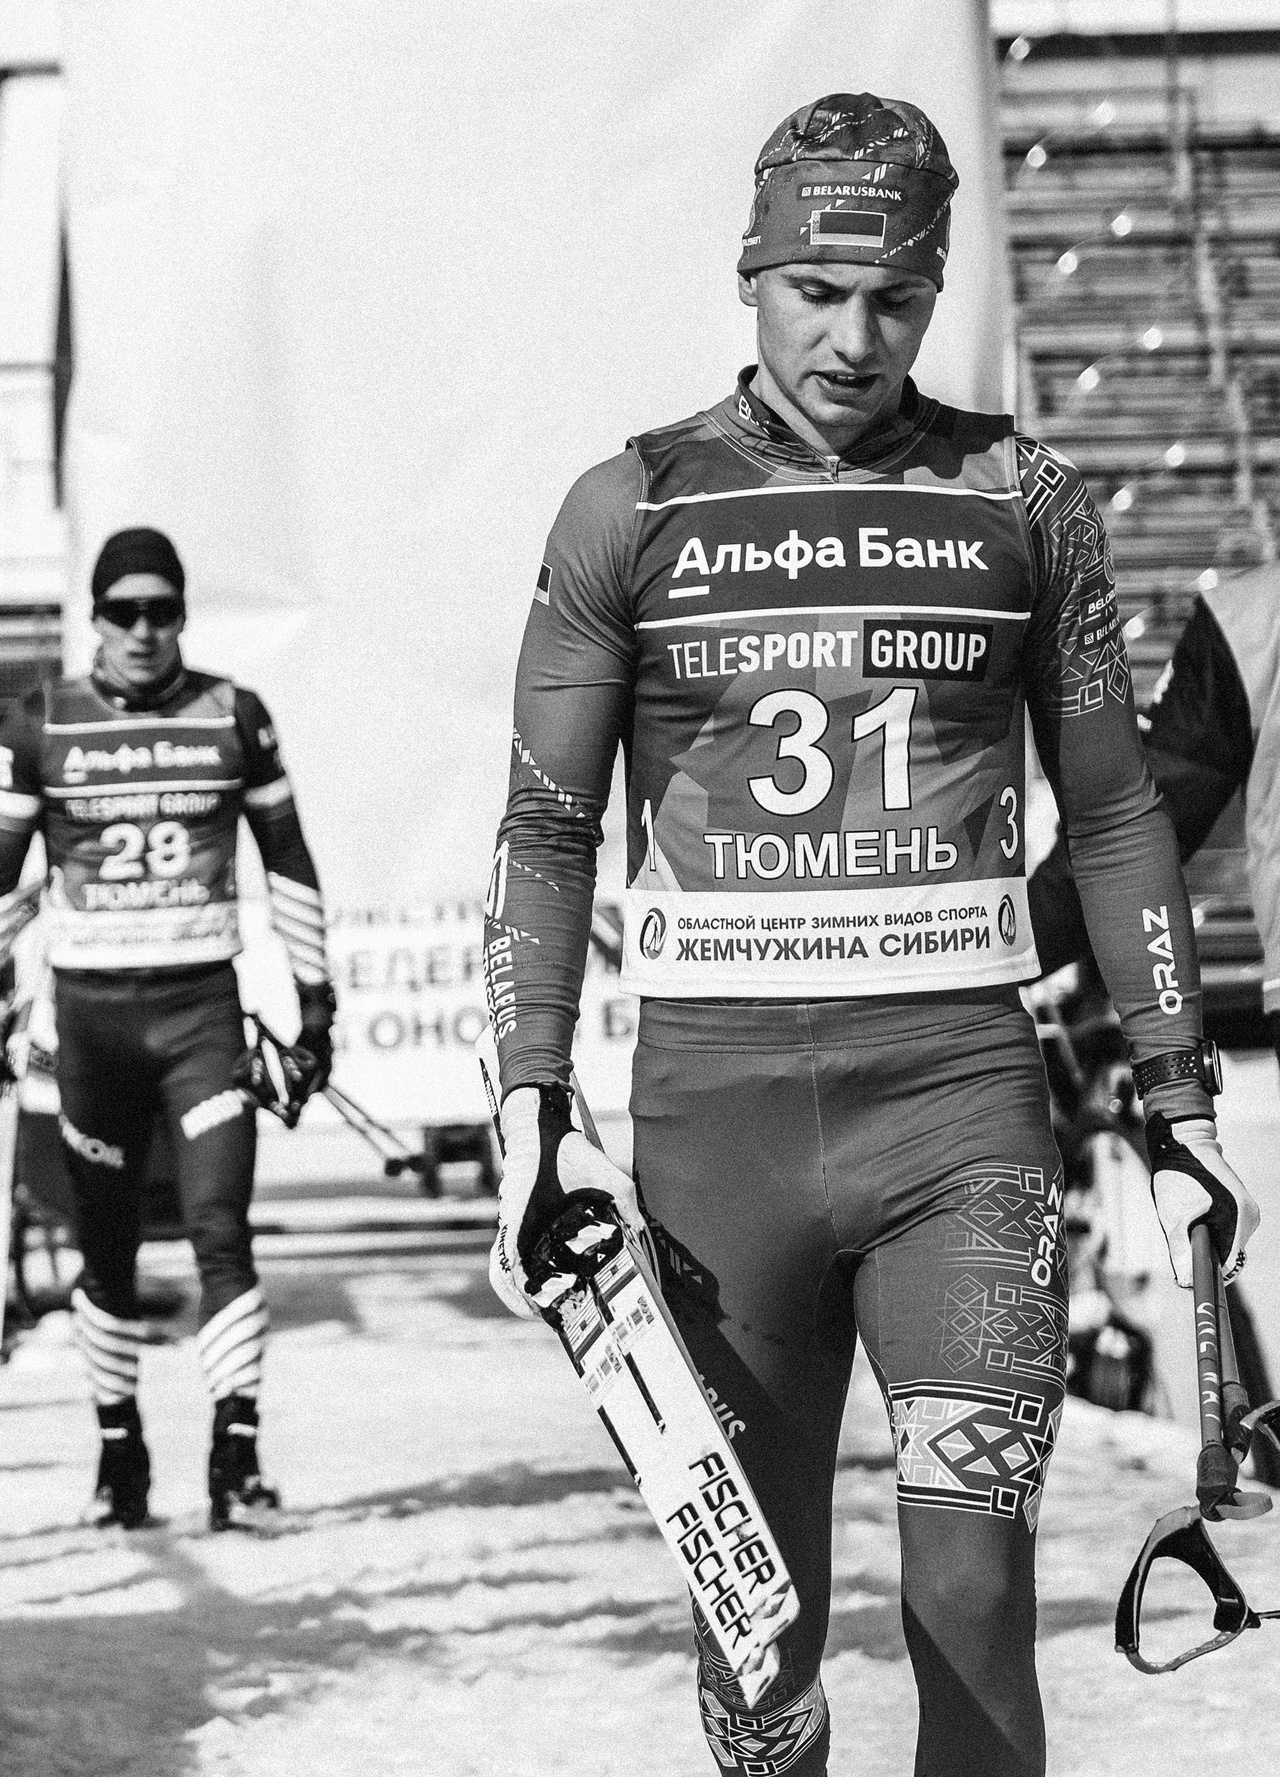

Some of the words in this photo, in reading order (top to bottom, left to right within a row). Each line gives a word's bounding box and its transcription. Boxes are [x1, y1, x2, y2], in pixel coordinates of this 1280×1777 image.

[812, 185, 902, 202] BELARUSBANK
[671, 529, 846, 581] Альфа
[858, 526, 990, 571] Банк
[667, 629, 859, 681] TELESPORT
[870, 628, 988, 672] GROUP
[746, 685, 919, 818] 31
[703, 826, 960, 881] ТЮМЕНЬ
[998, 785, 1020, 860] 3
[675, 935, 870, 962] ЖЕМЧУЖИНА
[879, 926, 992, 958] СИБИРИ
[677, 914, 756, 931] ОБЛАСТНОЙ
[761, 917, 807, 932] ЦЕНТР
[811, 914, 880, 929] ЗИМНИХ
[884, 911, 934, 926] ВИДОВ
[937, 905, 989, 922] СПОРТА
[489, 935, 517, 1039] BELARUS
[1142, 905, 1183, 1015] ORAZ
[1031, 1183, 1062, 1287] ORAZ
[688, 1451, 777, 1595] FISCHER
[665, 1501, 753, 1651] FISCHER
